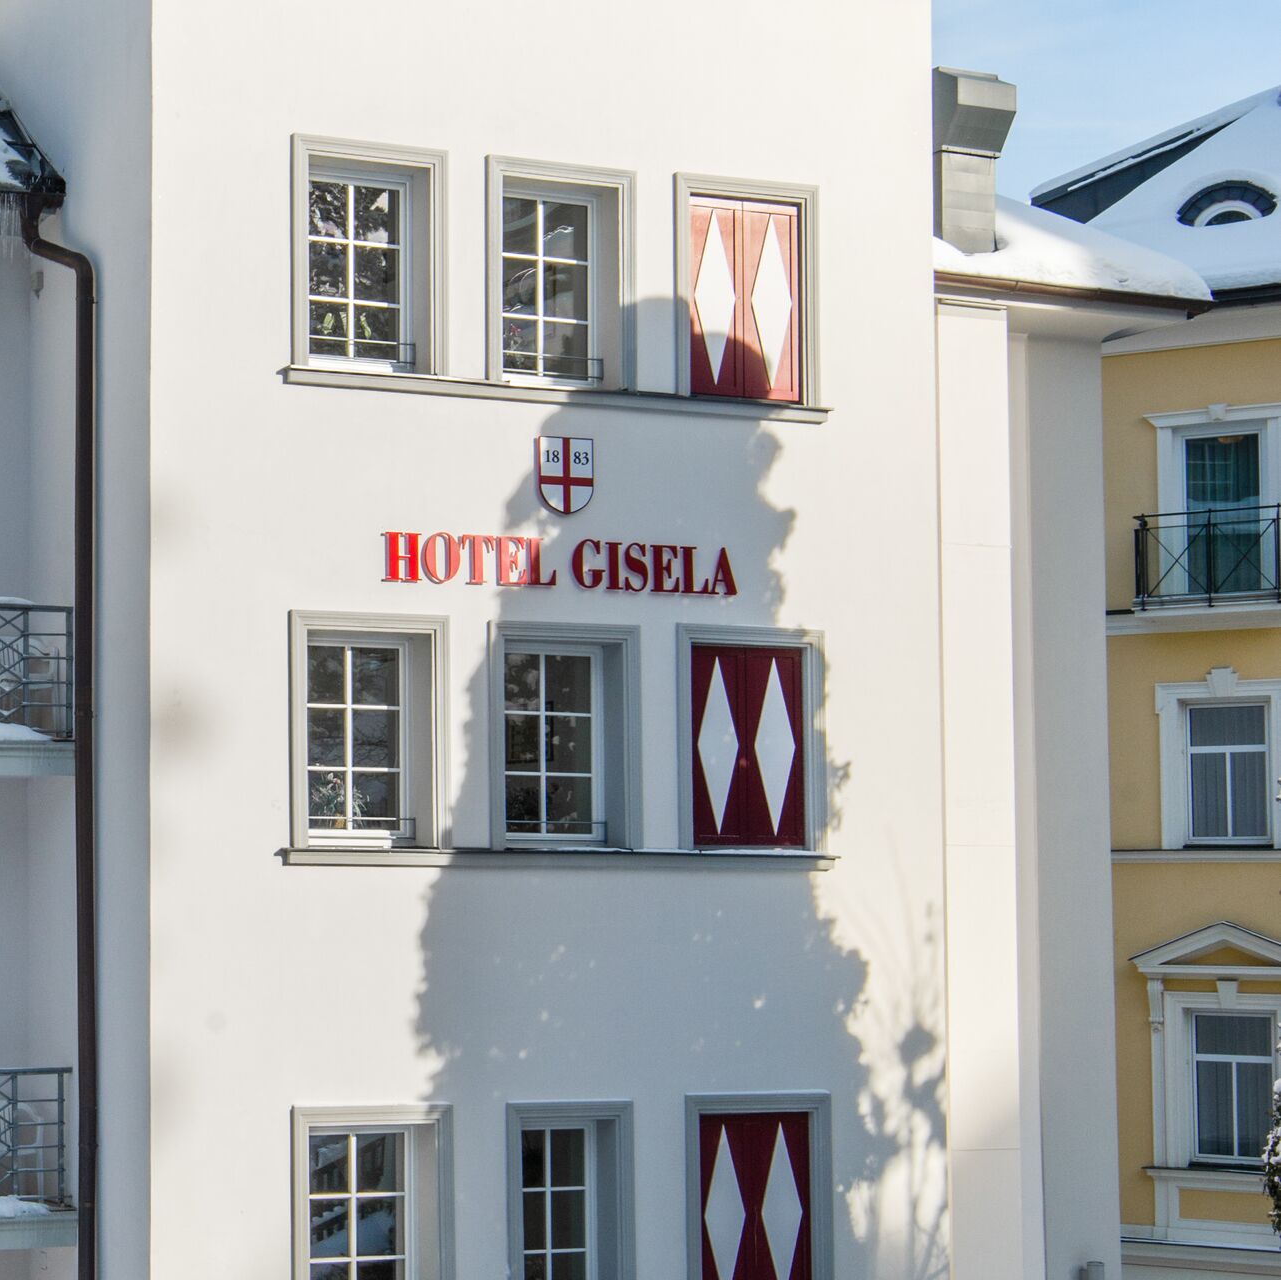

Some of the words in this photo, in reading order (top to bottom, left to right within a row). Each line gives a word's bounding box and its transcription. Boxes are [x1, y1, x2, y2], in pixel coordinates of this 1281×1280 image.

[545, 449, 560, 464] 18
[573, 450, 590, 466] 83
[381, 531, 557, 586] HOTEL
[571, 538, 738, 596] GISELA
